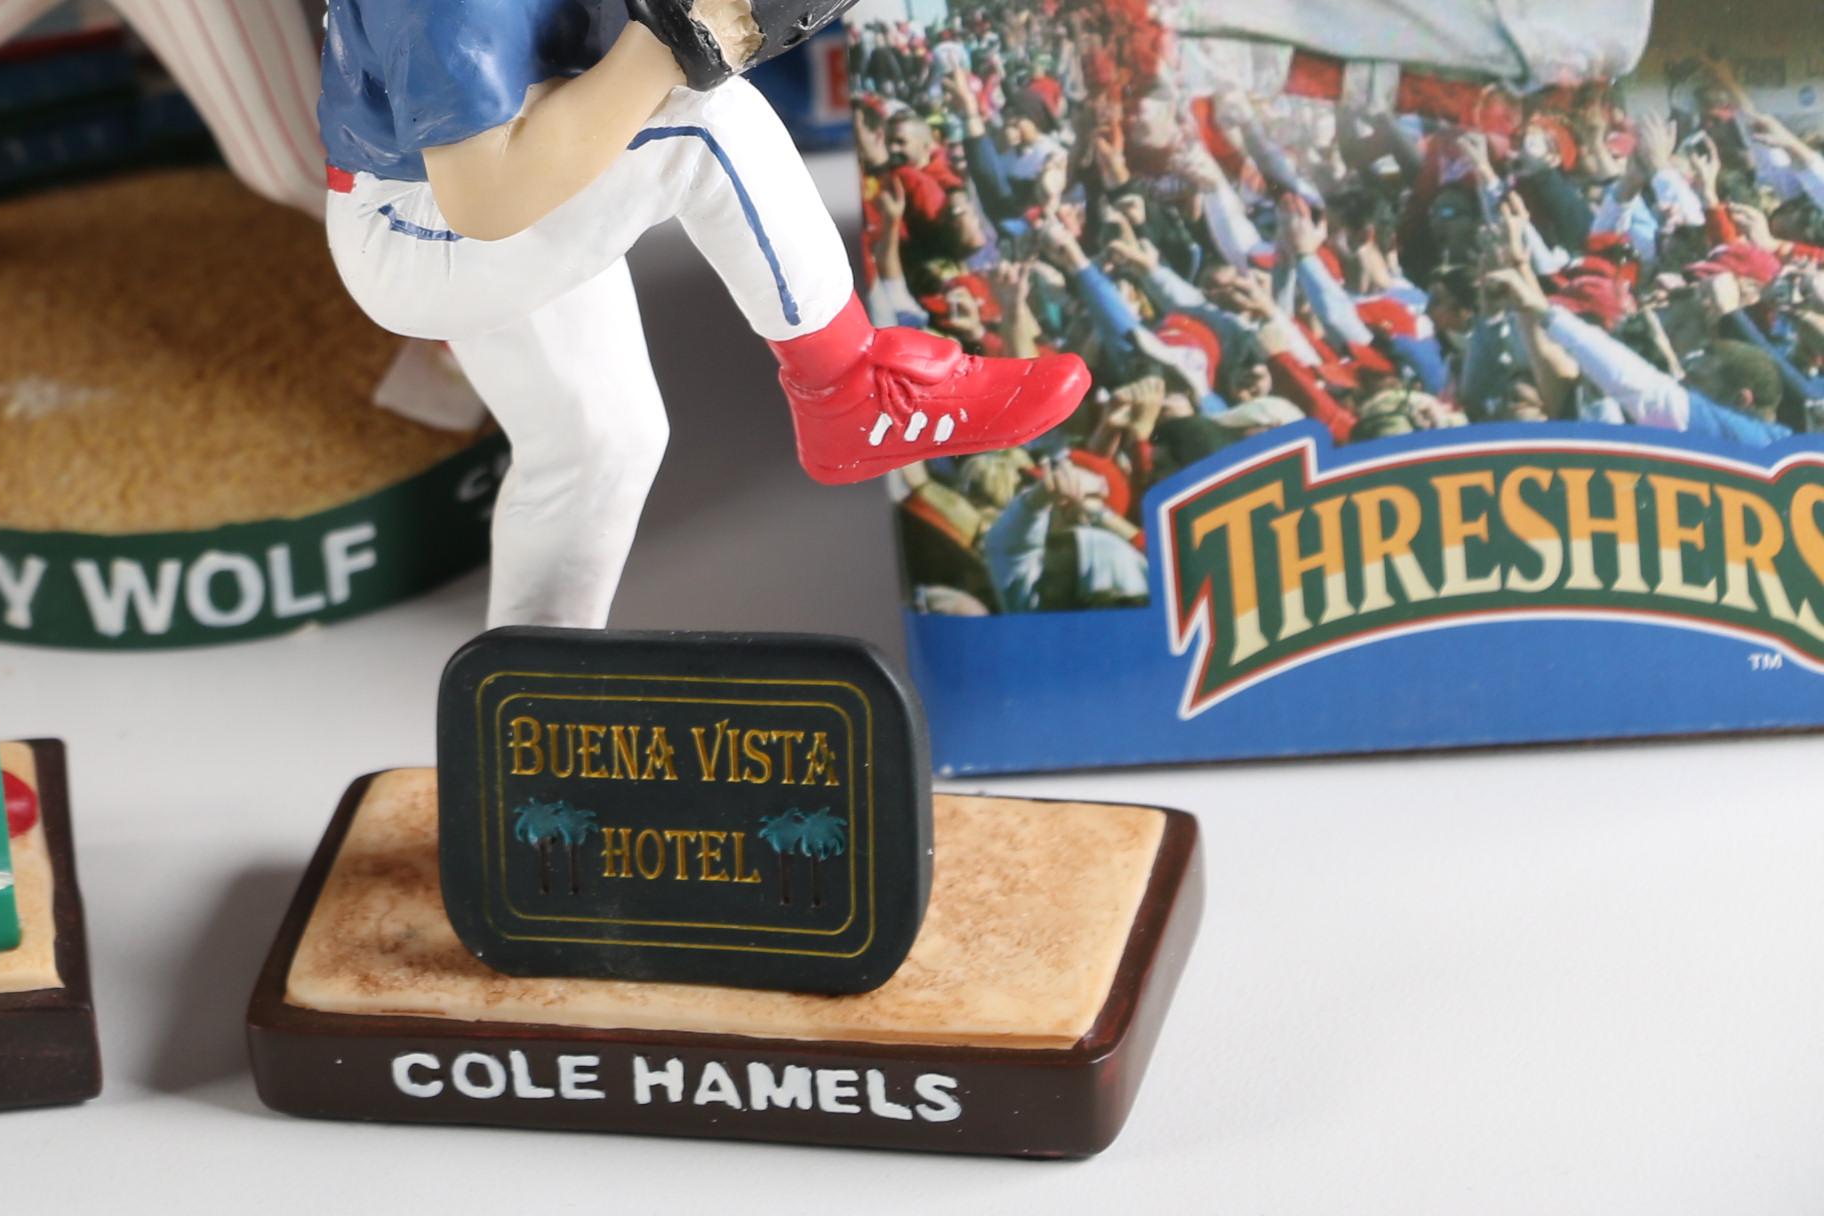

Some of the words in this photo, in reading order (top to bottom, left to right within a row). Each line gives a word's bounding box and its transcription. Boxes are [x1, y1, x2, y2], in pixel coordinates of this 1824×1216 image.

[75, 522, 377, 637] WOLF
[1747, 652, 1784, 672] TM
[508, 716, 678, 781] BUENA
[691, 718, 840, 786] VISTA
[600, 827, 763, 884] HOTEL
[391, 1049, 606, 1100] COLE
[632, 1054, 963, 1124] HAMELS
